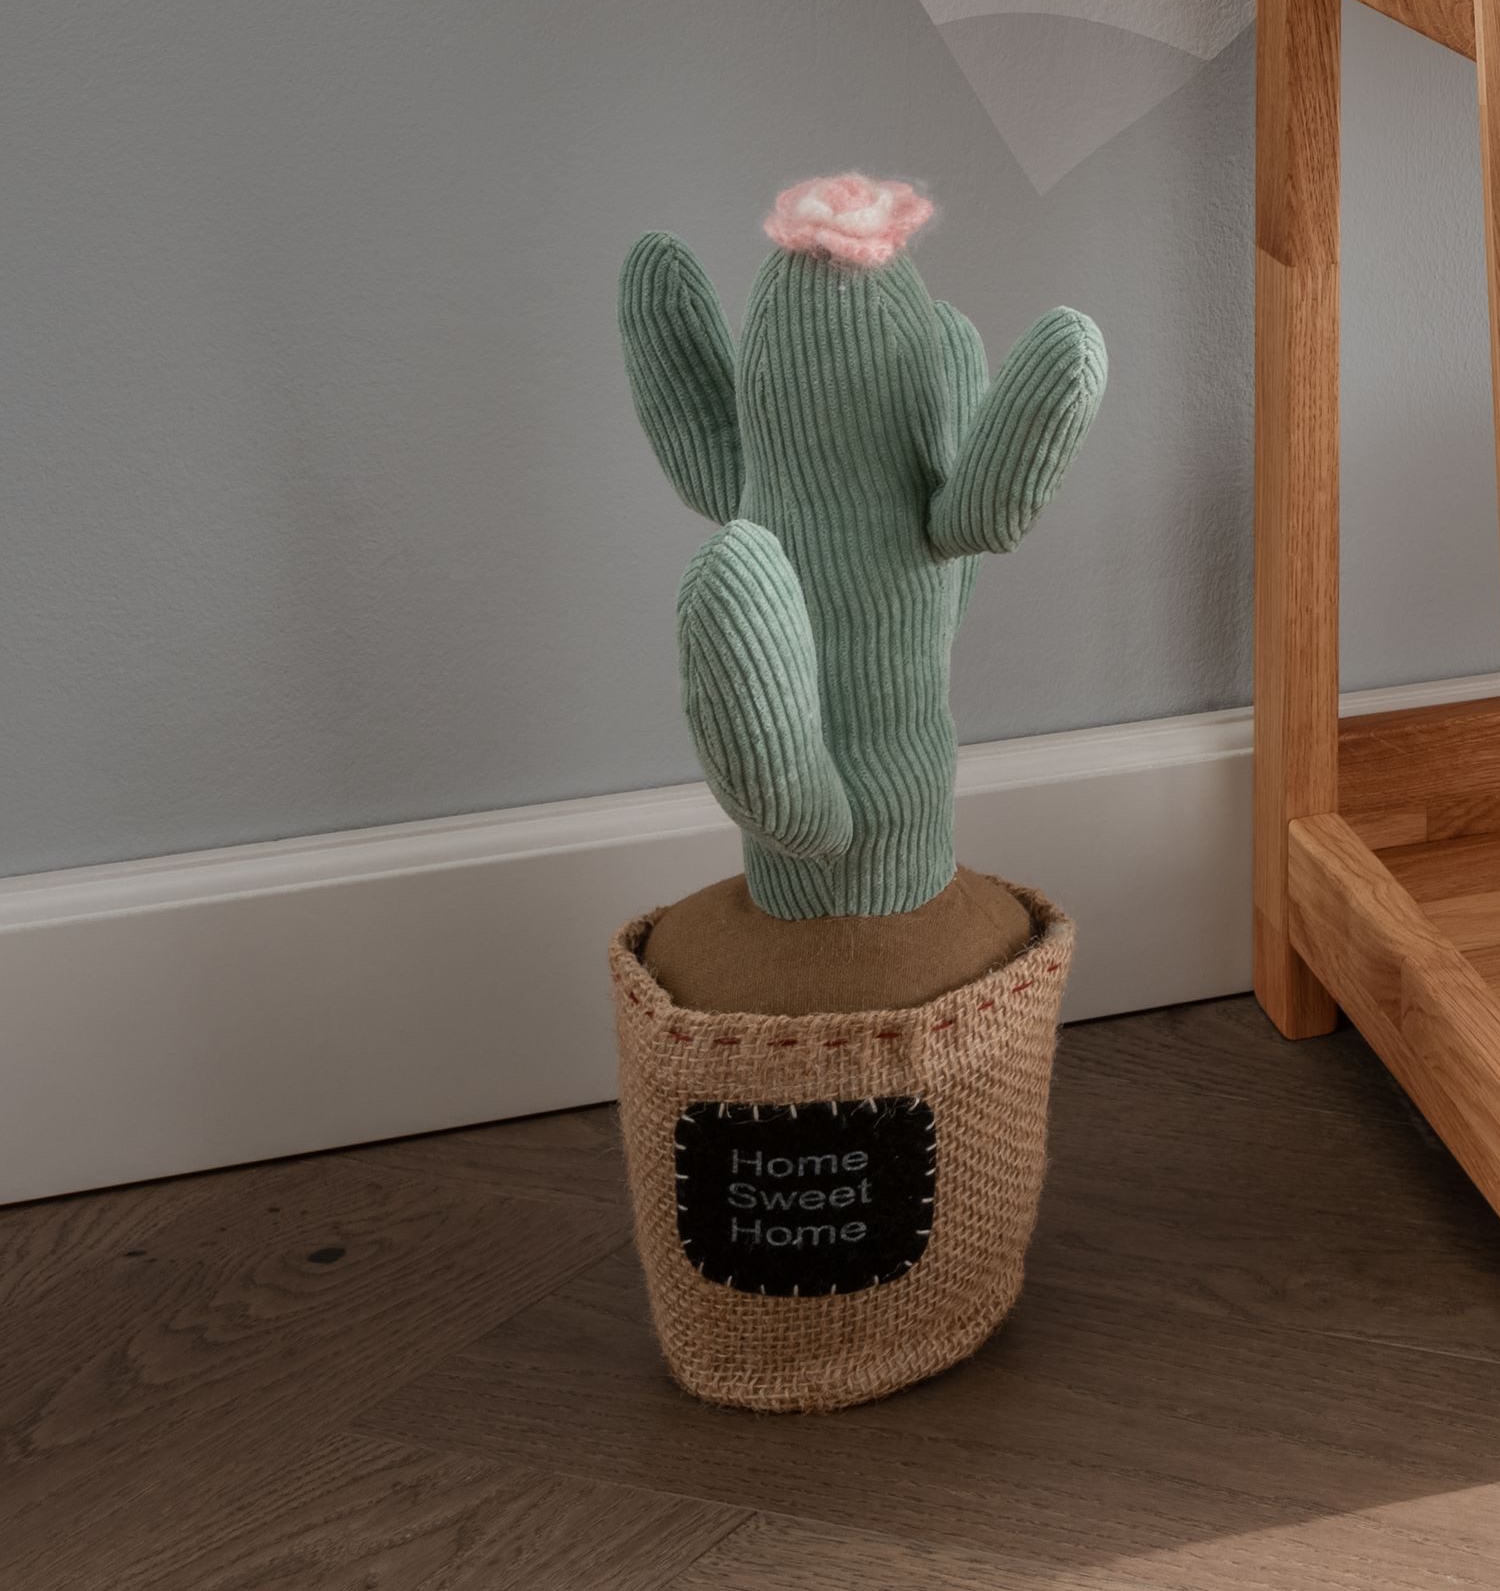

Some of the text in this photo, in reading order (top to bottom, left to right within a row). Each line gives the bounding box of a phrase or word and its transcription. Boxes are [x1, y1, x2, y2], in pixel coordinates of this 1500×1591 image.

[731, 1148, 870, 1178] Home
[727, 1177, 873, 1210] Sweet
[730, 1217, 868, 1247] Home
